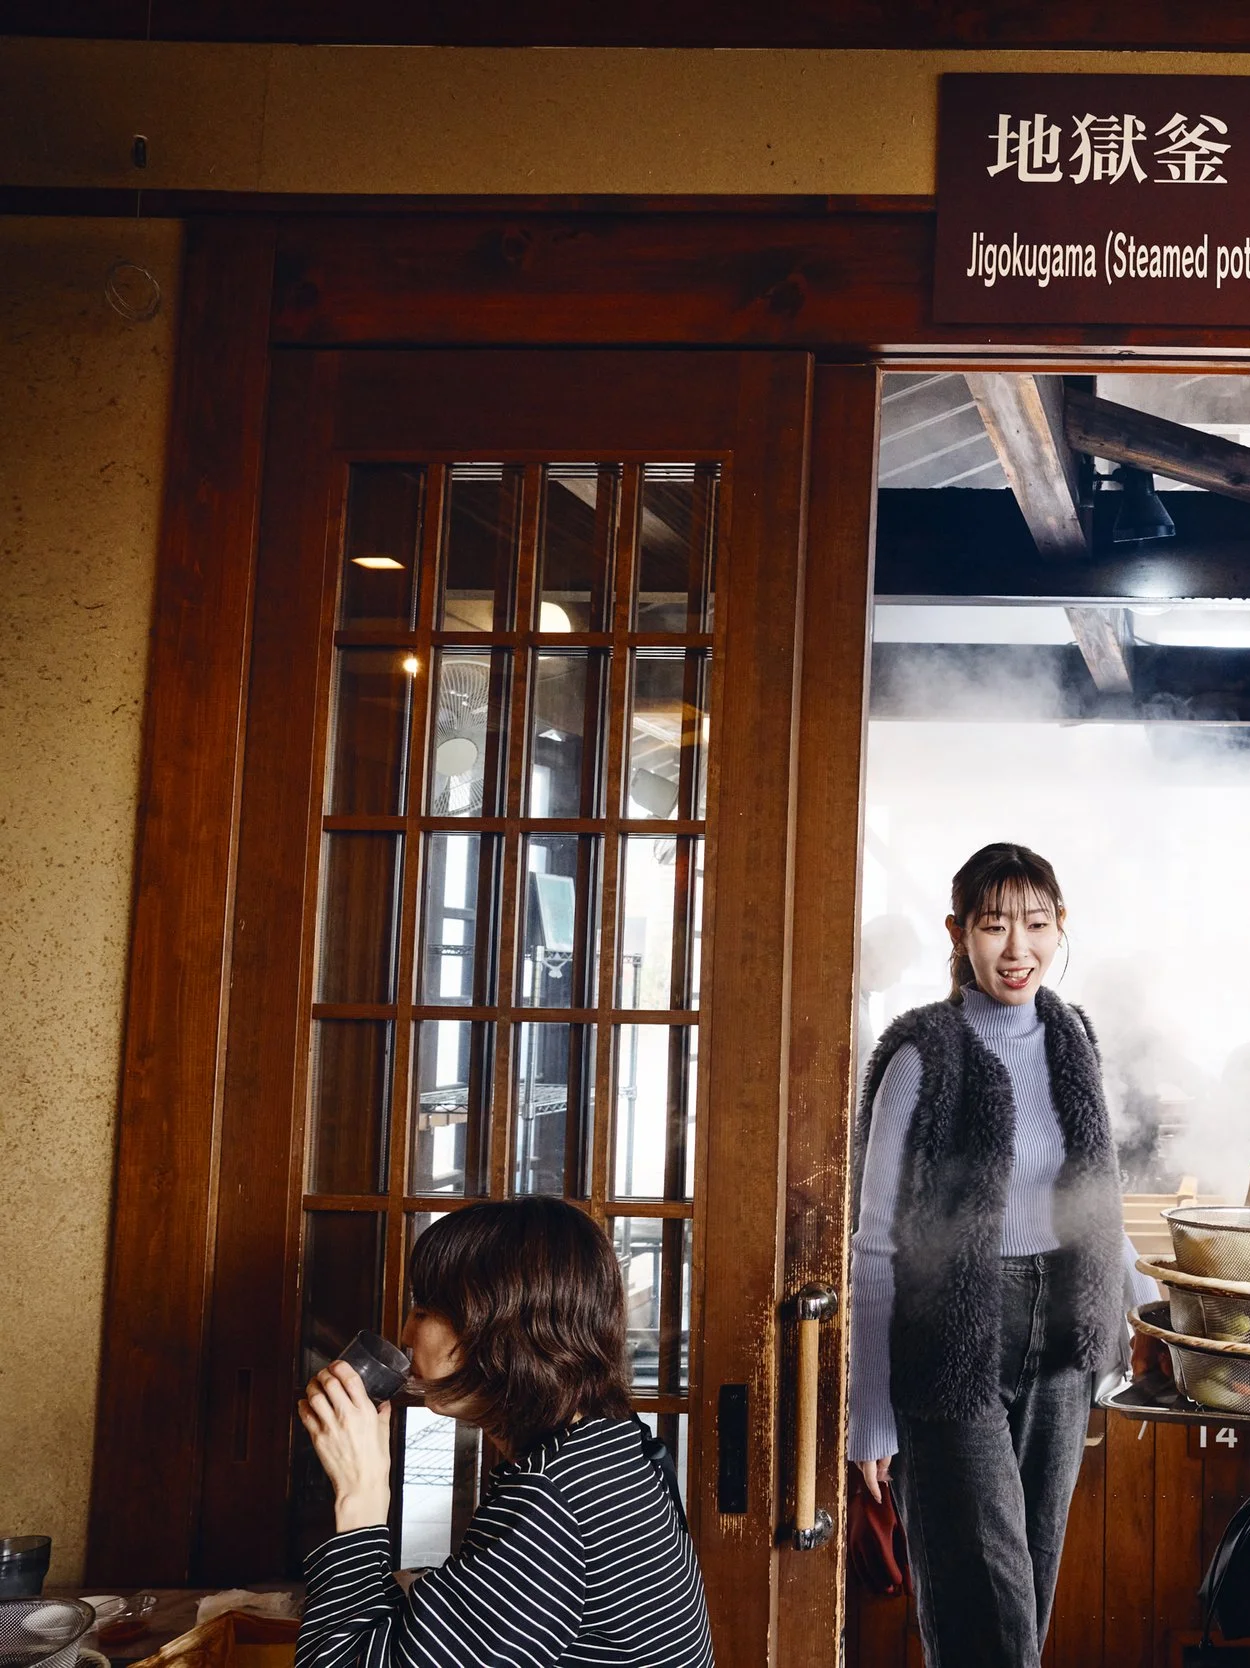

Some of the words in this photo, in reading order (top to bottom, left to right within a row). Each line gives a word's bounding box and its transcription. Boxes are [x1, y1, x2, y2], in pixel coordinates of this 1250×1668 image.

[986, 112, 1232, 185] 地獄釜
[966, 232, 1097, 288] Jigokugama
[1105, 230, 1210, 284] (Steamed
[1199, 1425, 1238, 1449] 14
